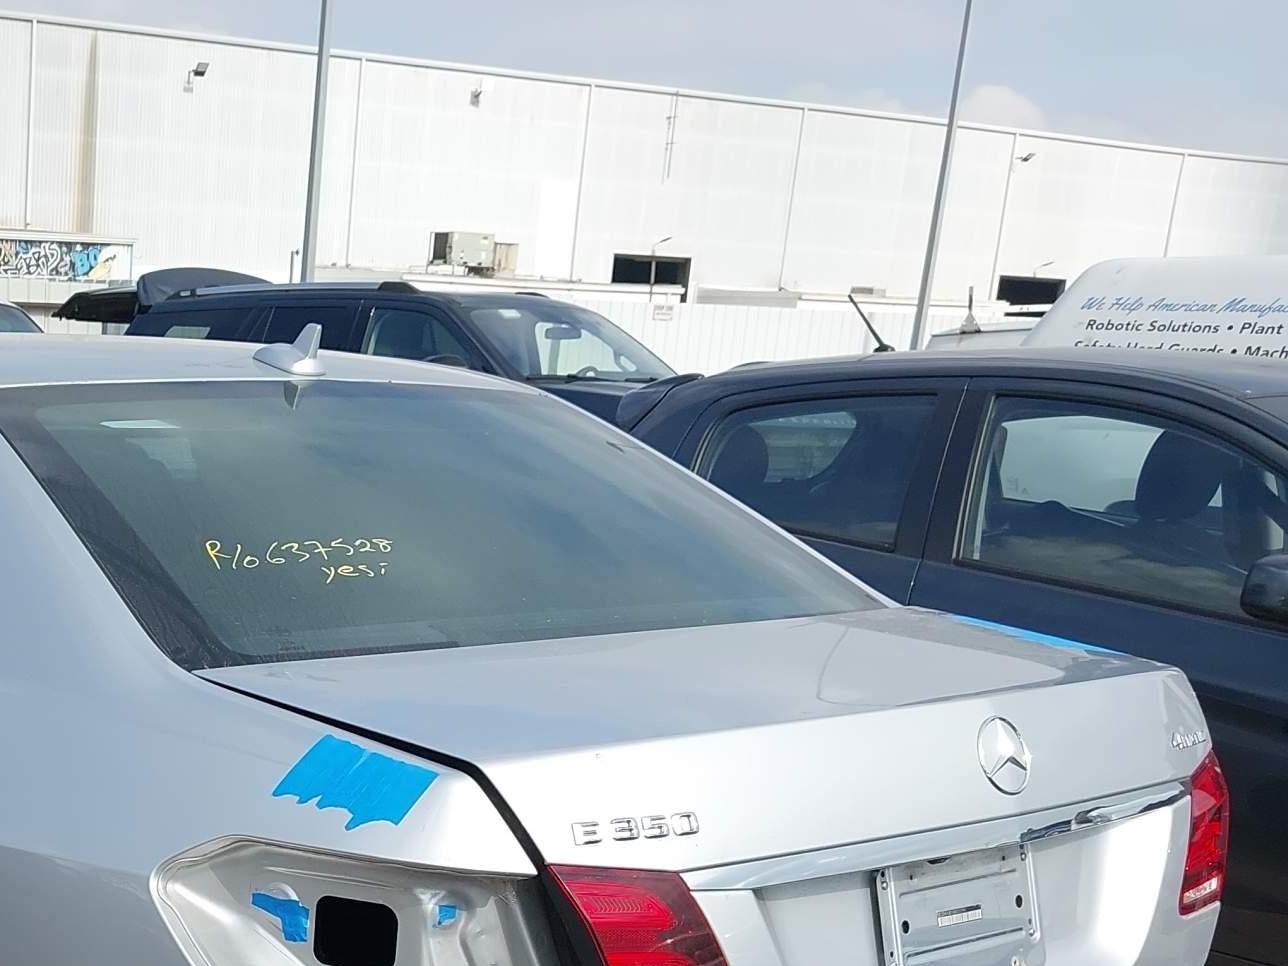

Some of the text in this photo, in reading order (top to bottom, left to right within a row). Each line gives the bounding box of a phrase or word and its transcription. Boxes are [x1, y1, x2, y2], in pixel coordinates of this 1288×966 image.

[1080, 296, 1105, 310] We
[1108, 296, 1144, 316] Help
[1146, 297, 1217, 313] American
[1085, 319, 1284, 335] Robotic Solutions Plant
[571, 811, 700, 846] E 350
